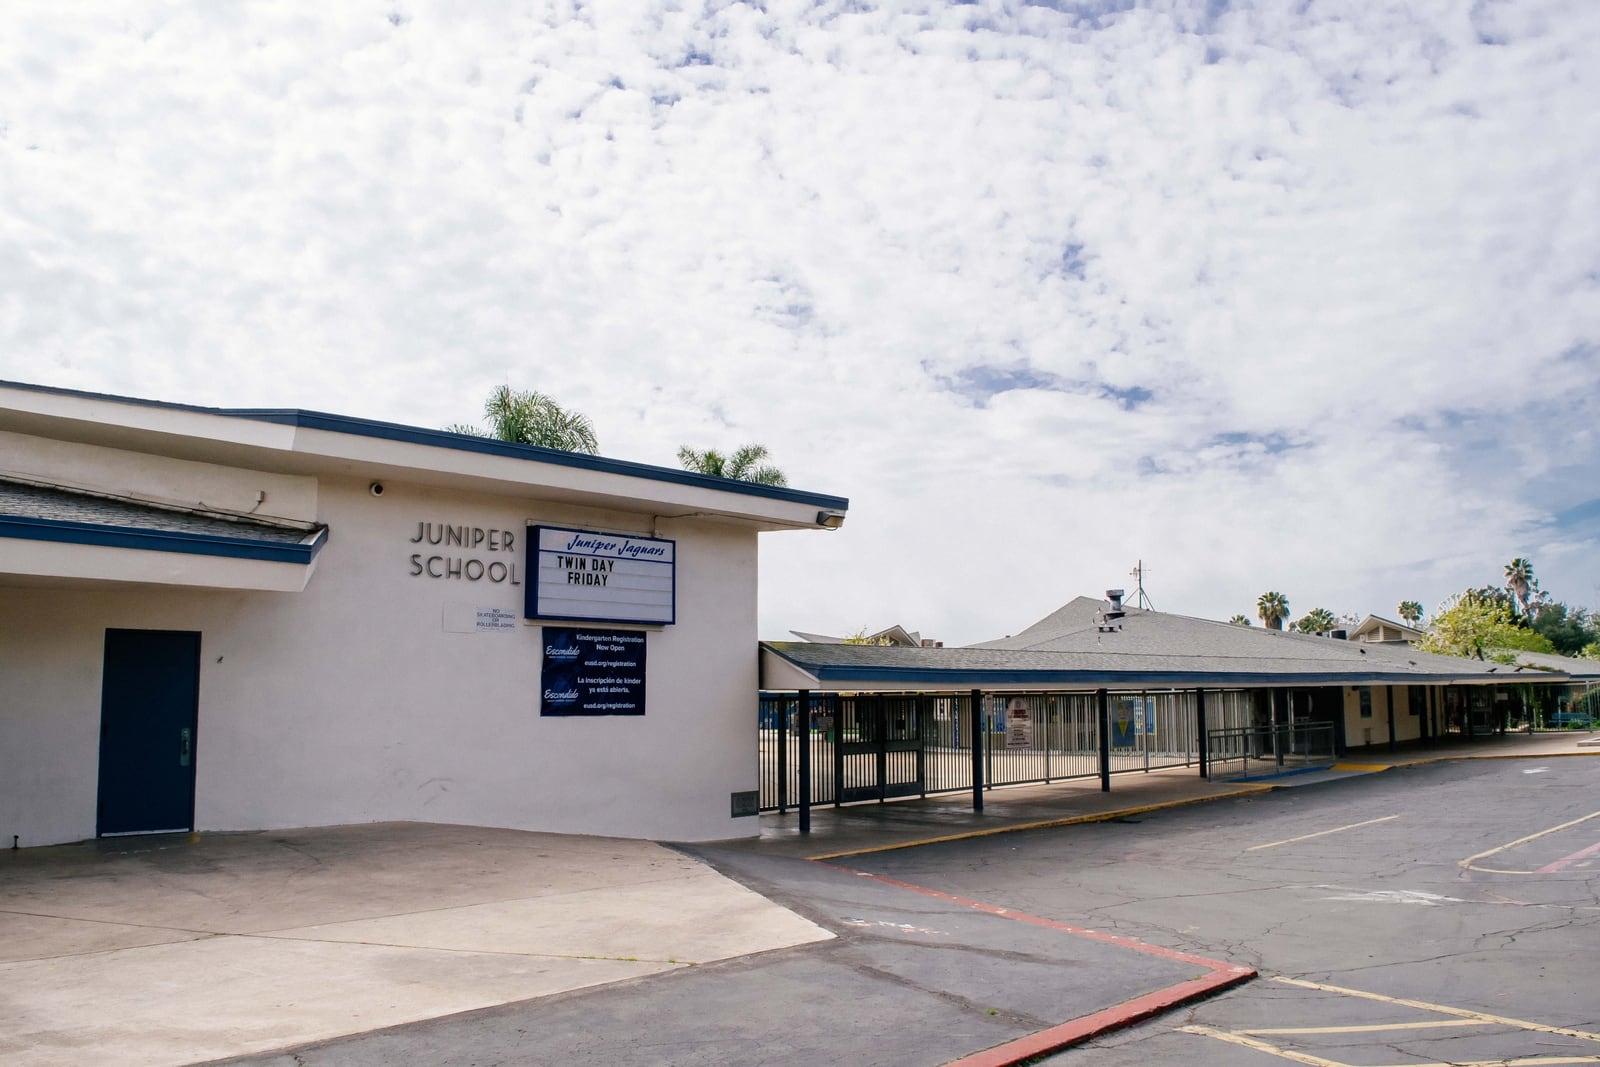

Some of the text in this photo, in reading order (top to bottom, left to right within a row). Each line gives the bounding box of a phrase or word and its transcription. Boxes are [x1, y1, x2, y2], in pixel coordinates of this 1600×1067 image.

[409, 521, 515, 552] JUNIPER
[567, 534, 665, 557] Juniper Jaguars
[557, 555, 615, 572] TWIN DAY
[409, 554, 521, 585] SCHOOL
[567, 571, 609, 587] FRIDAY
[576, 633, 645, 643] Kindergarten Registration
[545, 645, 580, 656] Escondido
[609, 644, 625, 652] Open
[584, 660, 637, 668] eusd.org/registration
[577, 676, 585, 684] La
[585, 677, 615, 685] inscripción
[624, 677, 641, 685] kinder
[544, 688, 579, 699] Escondido
[583, 702, 636, 710] eusd.org/registration
